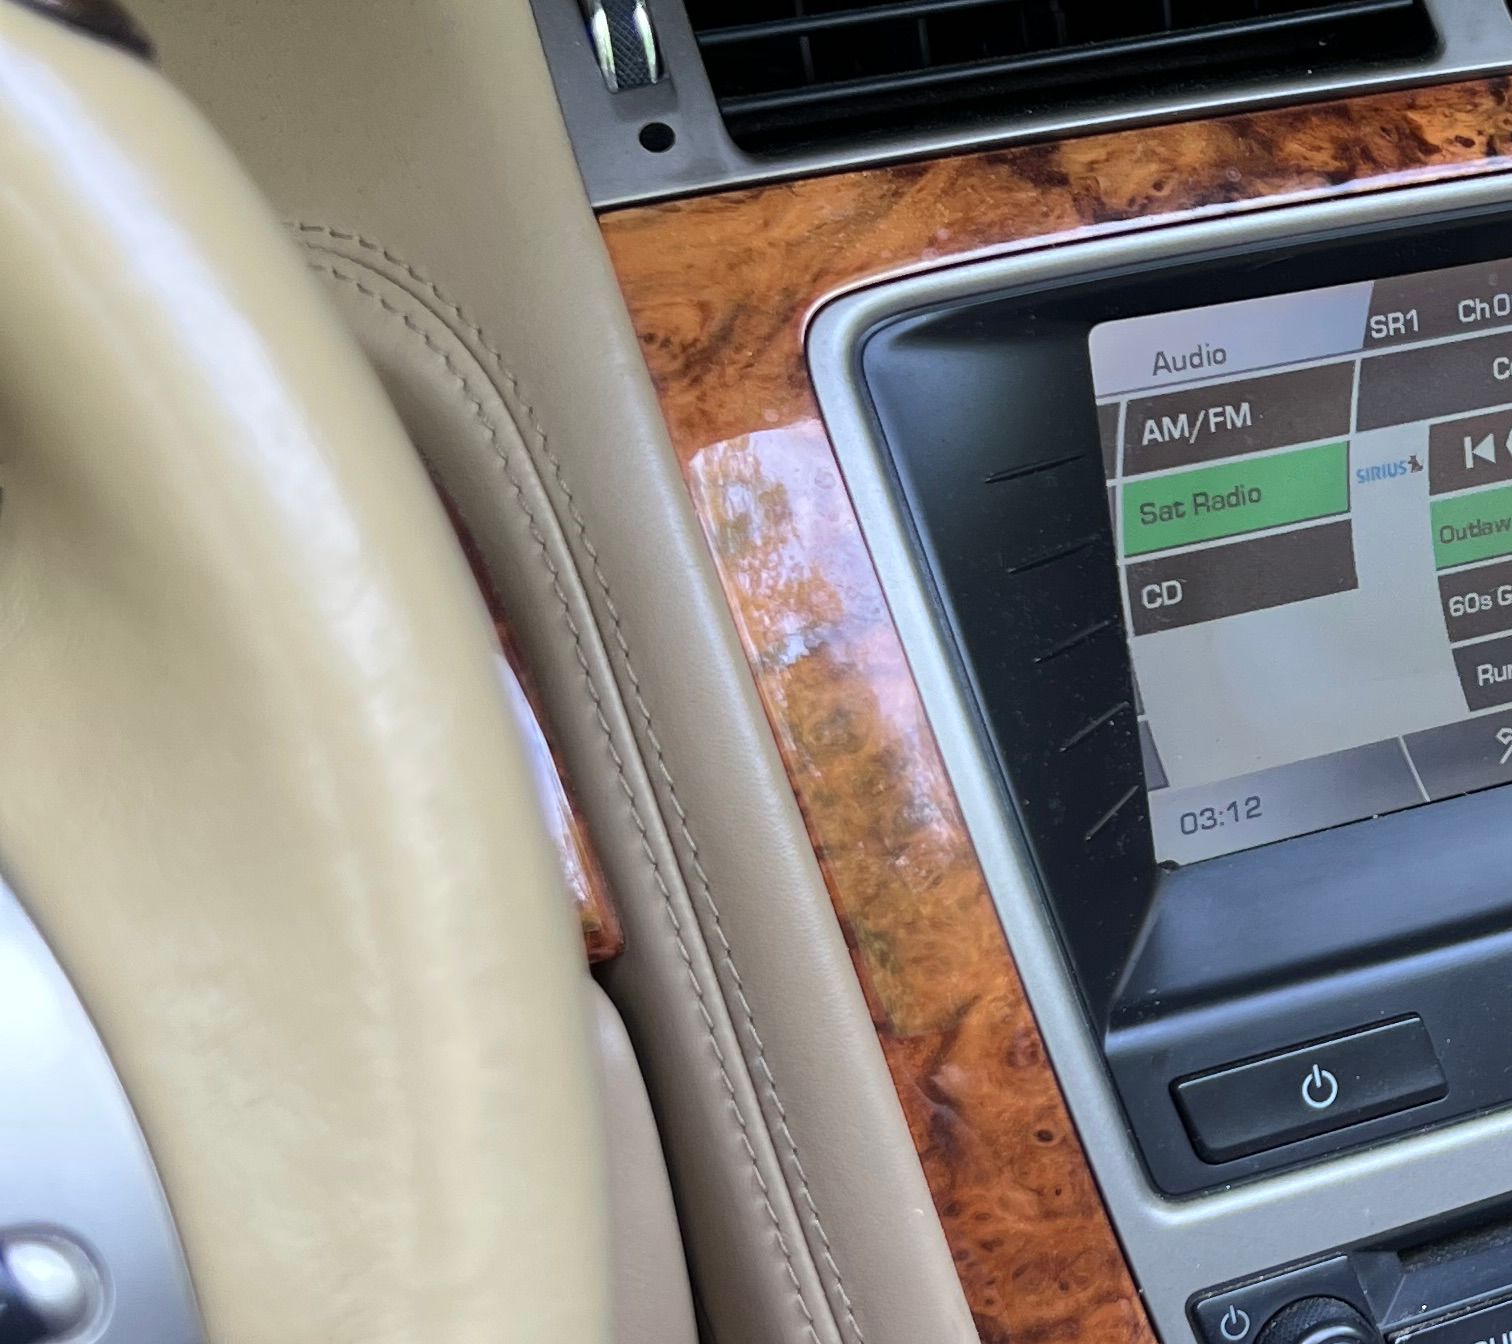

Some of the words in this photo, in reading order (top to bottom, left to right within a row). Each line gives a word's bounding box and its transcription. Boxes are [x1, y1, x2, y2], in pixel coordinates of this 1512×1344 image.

[1370, 309, 1420, 340] SR1
[1152, 343, 1228, 376] Audio
[1141, 402, 1253, 446] AM/FM
[1355, 460, 1408, 485] SIRIUS
[1139, 498, 1186, 526] Sat
[1193, 484, 1263, 514] Radio
[1439, 513, 1512, 545] Outlaw
[1141, 580, 1184, 610] CD
[1448, 591, 1493, 618] 60s
[1180, 795, 1263, 835] 03:12
